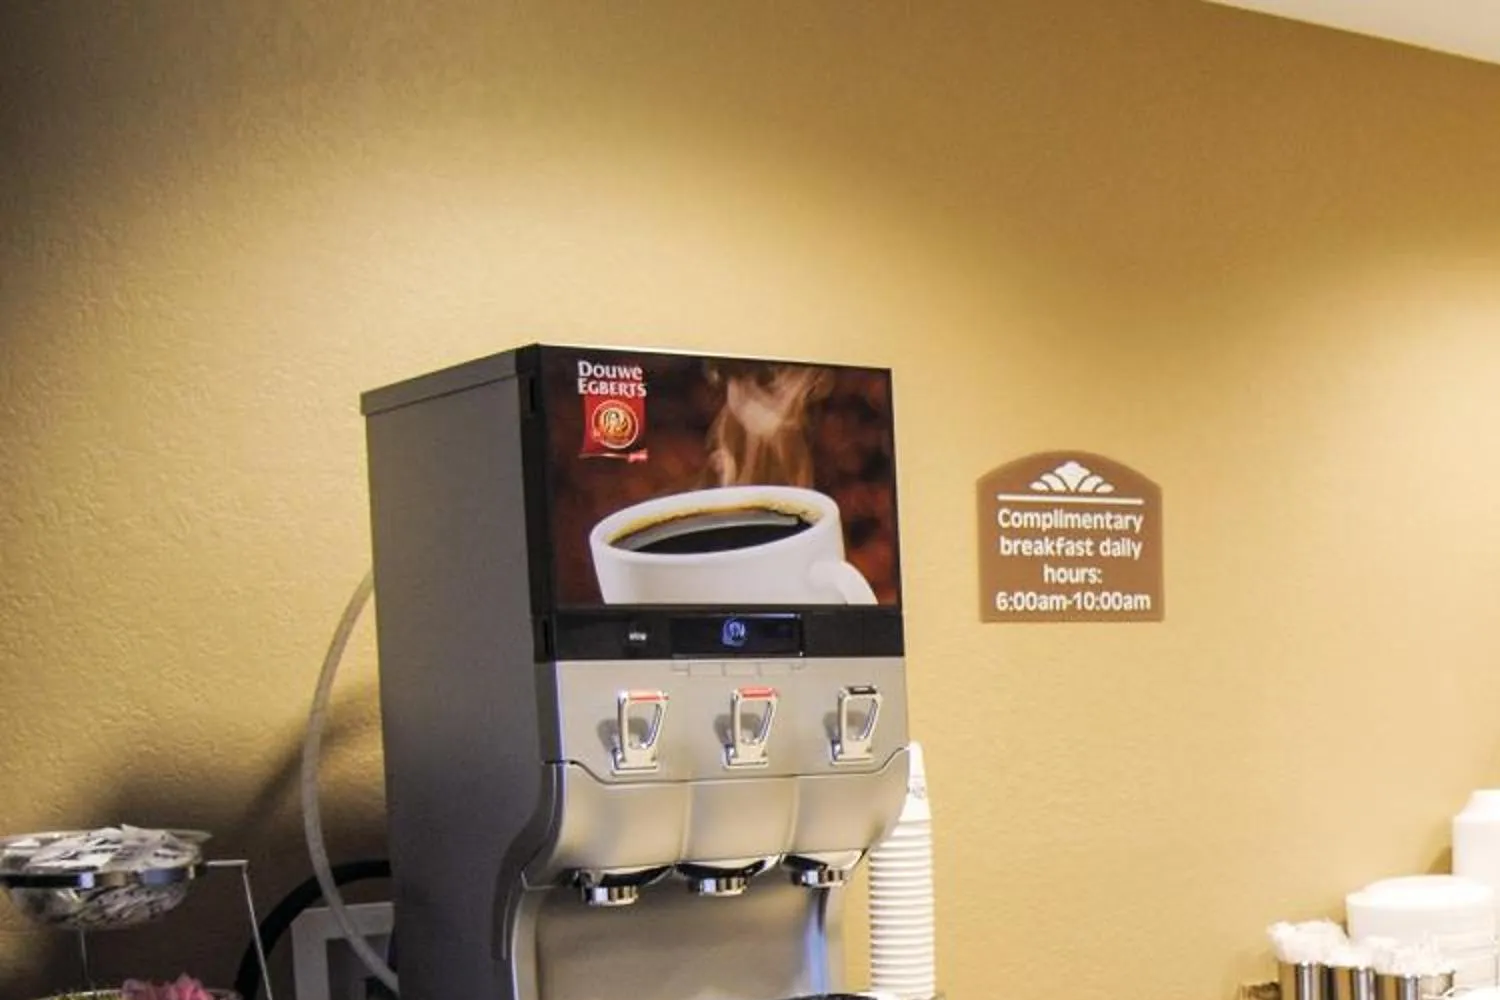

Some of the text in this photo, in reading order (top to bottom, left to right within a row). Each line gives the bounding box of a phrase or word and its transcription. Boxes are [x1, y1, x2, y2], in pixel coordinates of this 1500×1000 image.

[578, 361, 643, 381] Douwe
[578, 378, 647, 398] EGBERTS
[998, 508, 1144, 533] Complimentary
[1000, 535, 1143, 560] breakfast daily
[1043, 564, 1103, 584] hours:
[996, 591, 1151, 612] 6:00am-10:00am
